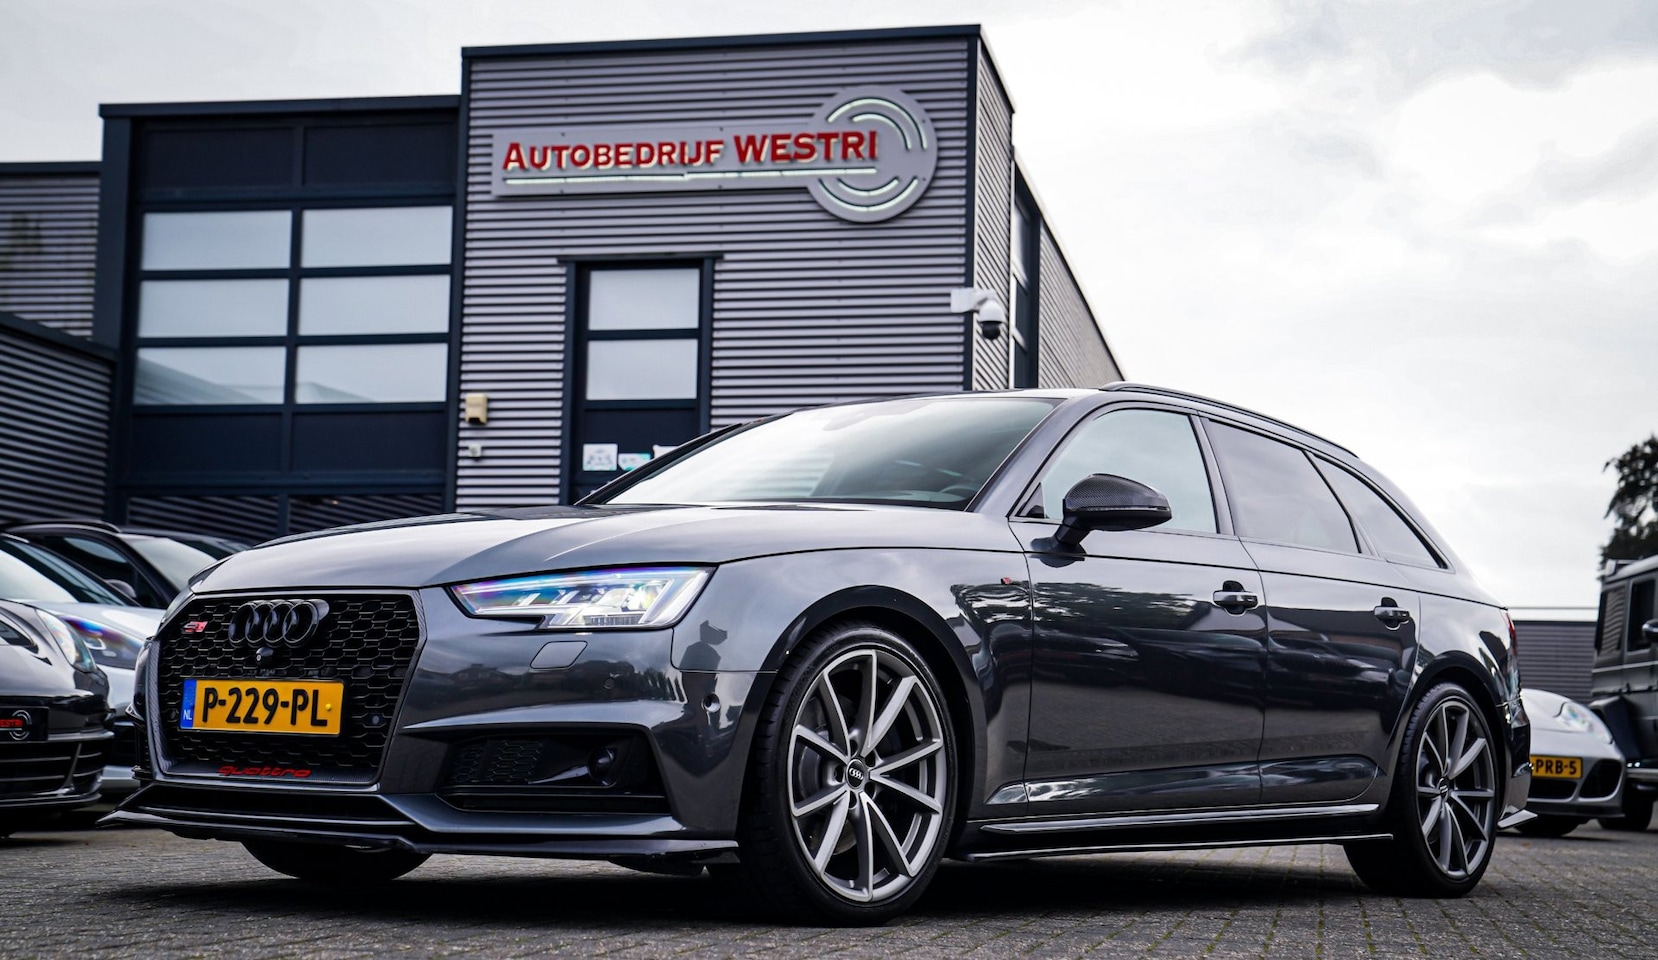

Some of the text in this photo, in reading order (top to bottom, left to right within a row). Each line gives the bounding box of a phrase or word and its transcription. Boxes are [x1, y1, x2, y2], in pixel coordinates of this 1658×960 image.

[503, 130, 877, 169] AUTOBEDRIJF WESTRI
[183, 687, 328, 727] NL P-229-PL
[217, 765, 312, 778] quattro
